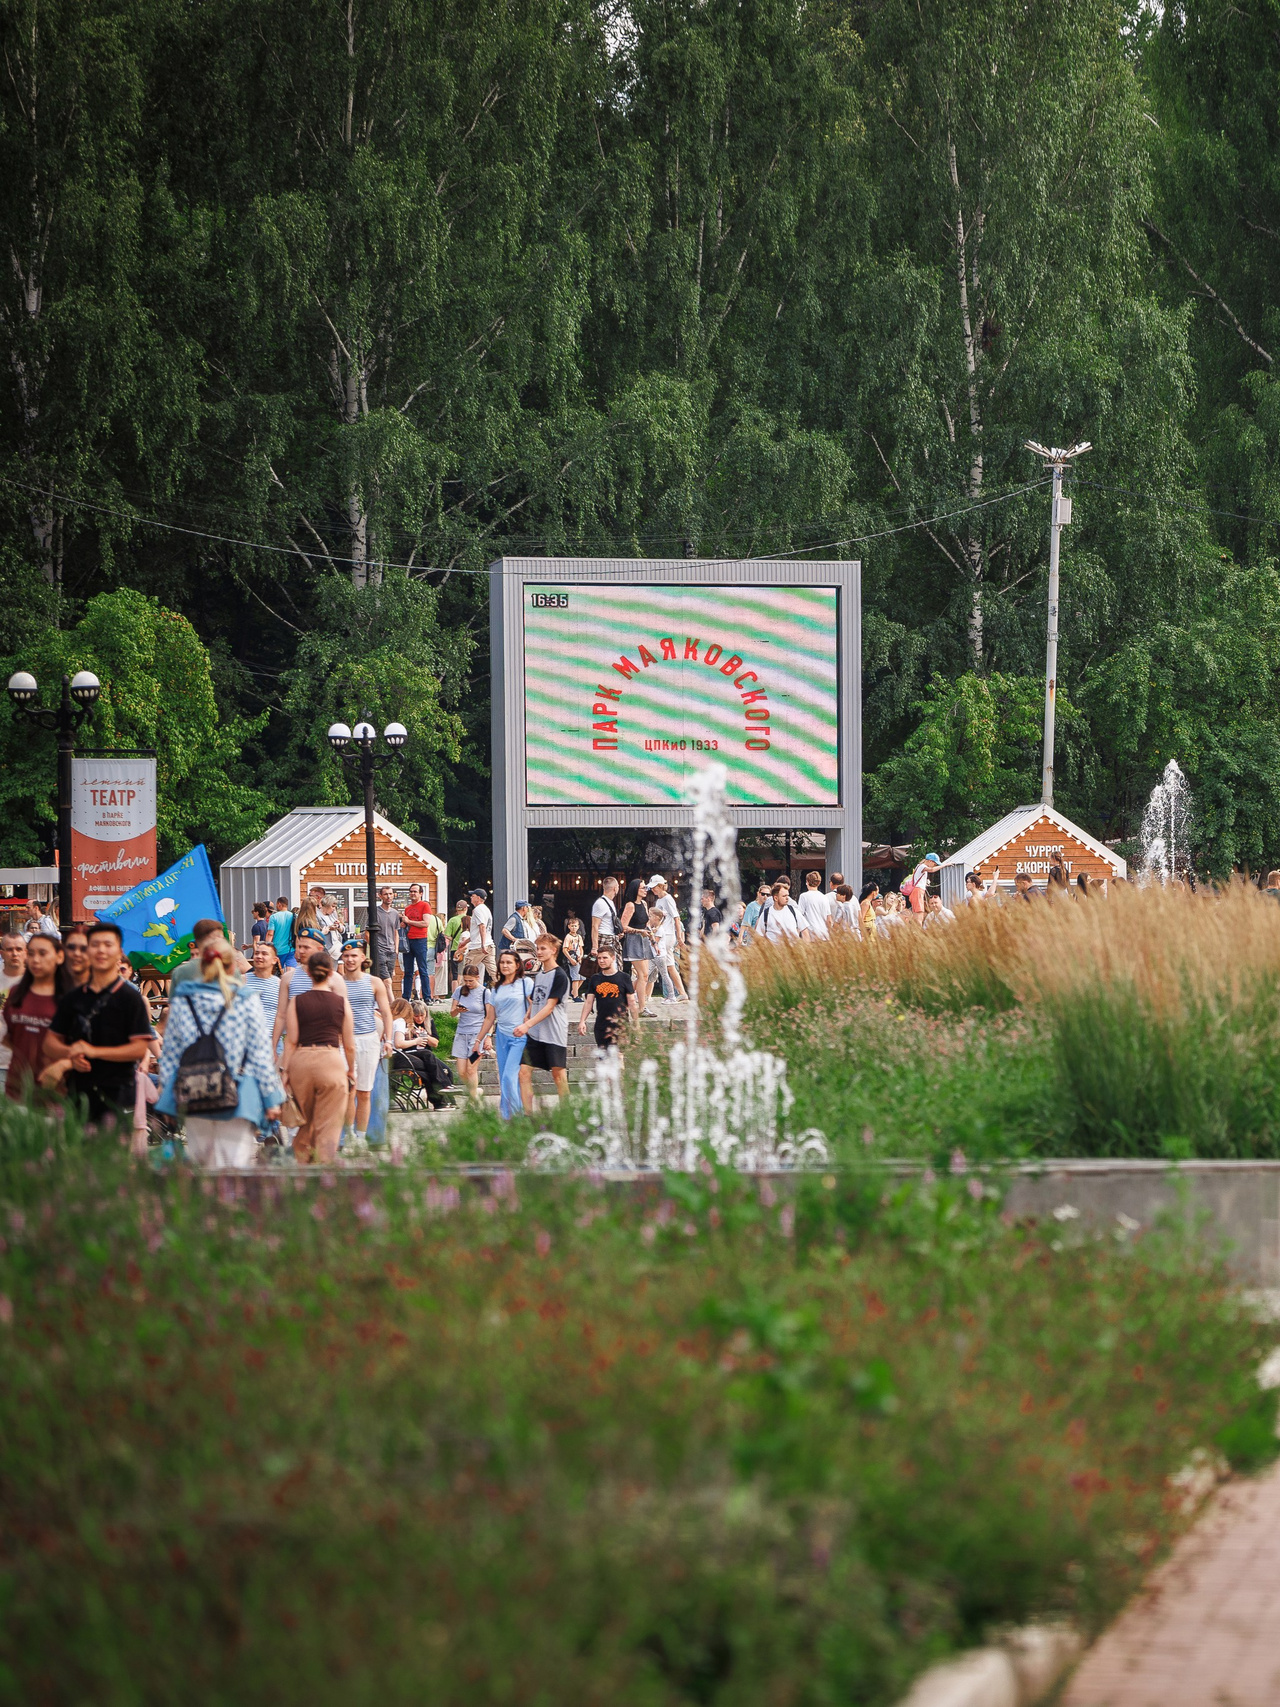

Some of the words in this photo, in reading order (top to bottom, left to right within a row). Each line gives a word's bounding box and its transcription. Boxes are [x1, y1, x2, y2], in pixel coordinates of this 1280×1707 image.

[531, 594, 569, 608] 16:35
[592, 684, 622, 751] ПАРК
[612, 637, 771, 751] МАЯКОВСКОГО
[645, 740, 687, 752] ЦПКиО
[692, 740, 718, 751] 1933
[90, 789, 136, 806] ТЕАТР
[334, 863, 367, 875] TUTTO
